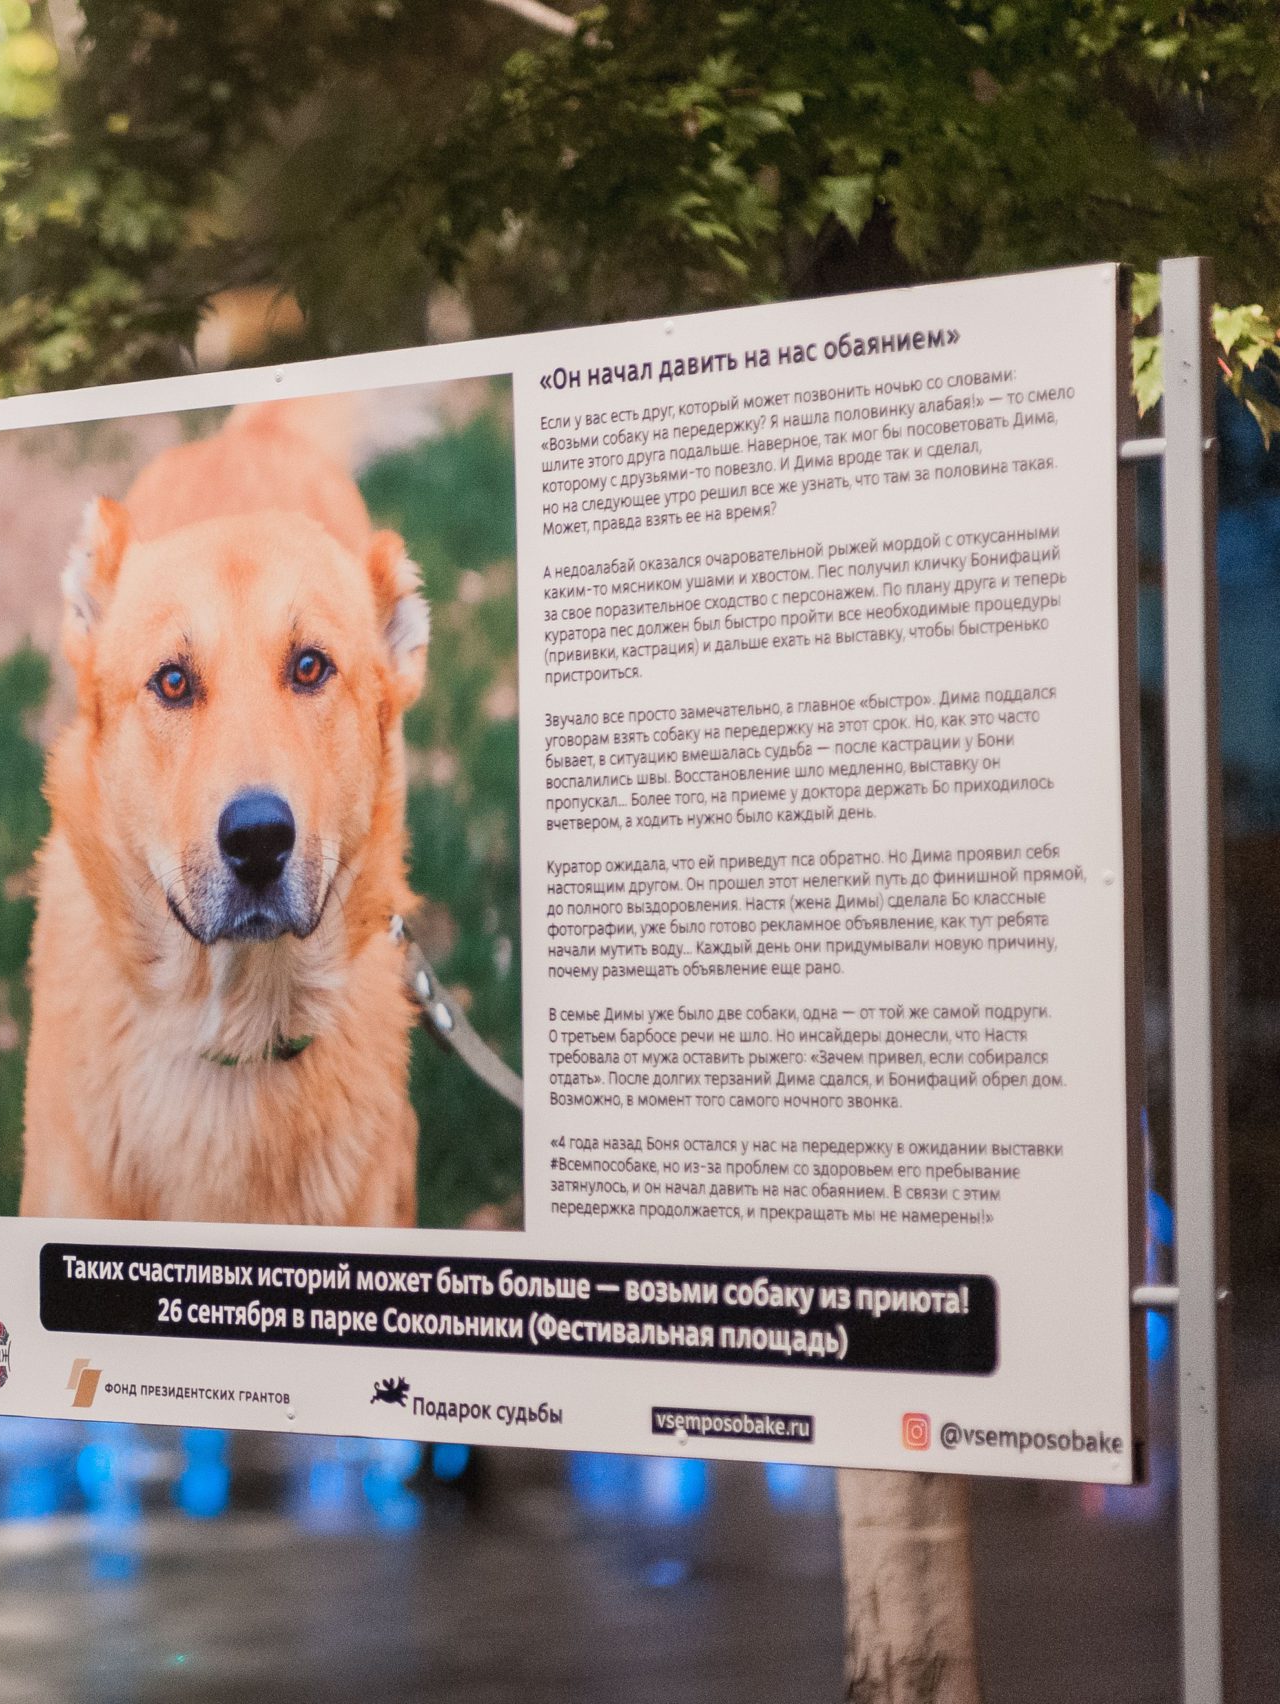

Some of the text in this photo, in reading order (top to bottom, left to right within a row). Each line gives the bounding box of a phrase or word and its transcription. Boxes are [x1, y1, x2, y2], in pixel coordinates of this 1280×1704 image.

[539, 328, 960, 390] «Он начал давить на нас обаянием»
[541, 411, 1057, 473] шлите этого друга подальше. Наверное, так мог бы посоветовать Дима,
[543, 526, 1059, 579] А недоалабай оказался очаровательной рыжей мордой с откусанными
[543, 544, 1060, 599] каким-то мясником ушами и хвостом. Пес получил кличку Бонифаций
[544, 686, 1056, 730] Звучало все просто замечательно, а главное «быстро». Дима поддался
[547, 842, 1060, 877] Куратор ожидала, что ей приведут пса обратно. Но Дима проявил себя
[547, 864, 1086, 896] настоящим другом. Он прошел этот нелегкий путь до финишной прямой,
[550, 1156, 1020, 1181] #Всемпособаке, но из-за проблем со здоровьем его пребывание
[551, 1201, 994, 1227] передержка продолжается, и прекращать мы не намерены!»
[62, 1255, 123, 1280] Таких
[128, 1261, 252, 1285] счастливых
[258, 1263, 350, 1291] историй
[356, 1270, 432, 1292] может
[436, 1266, 494, 1295] быть
[498, 1268, 590, 1299] больше
[625, 1279, 718, 1304] возьми
[723, 1277, 814, 1312] собаку
[819, 1287, 851, 1309] из
[856, 1286, 968, 1315] приюта!
[157, 1297, 848, 1358] 26 сентября в парке Сокольники (Фестивальная площадь)
[105, 1383, 290, 1404] ФОНД ПРЕЗИДЕНТСКИХ ГРАНТОВ
[414, 1397, 562, 1425] Подарок судьбы
[655, 1412, 811, 1438] vsemposobake.ru
[940, 1422, 1122, 1453] @vsemposobake
